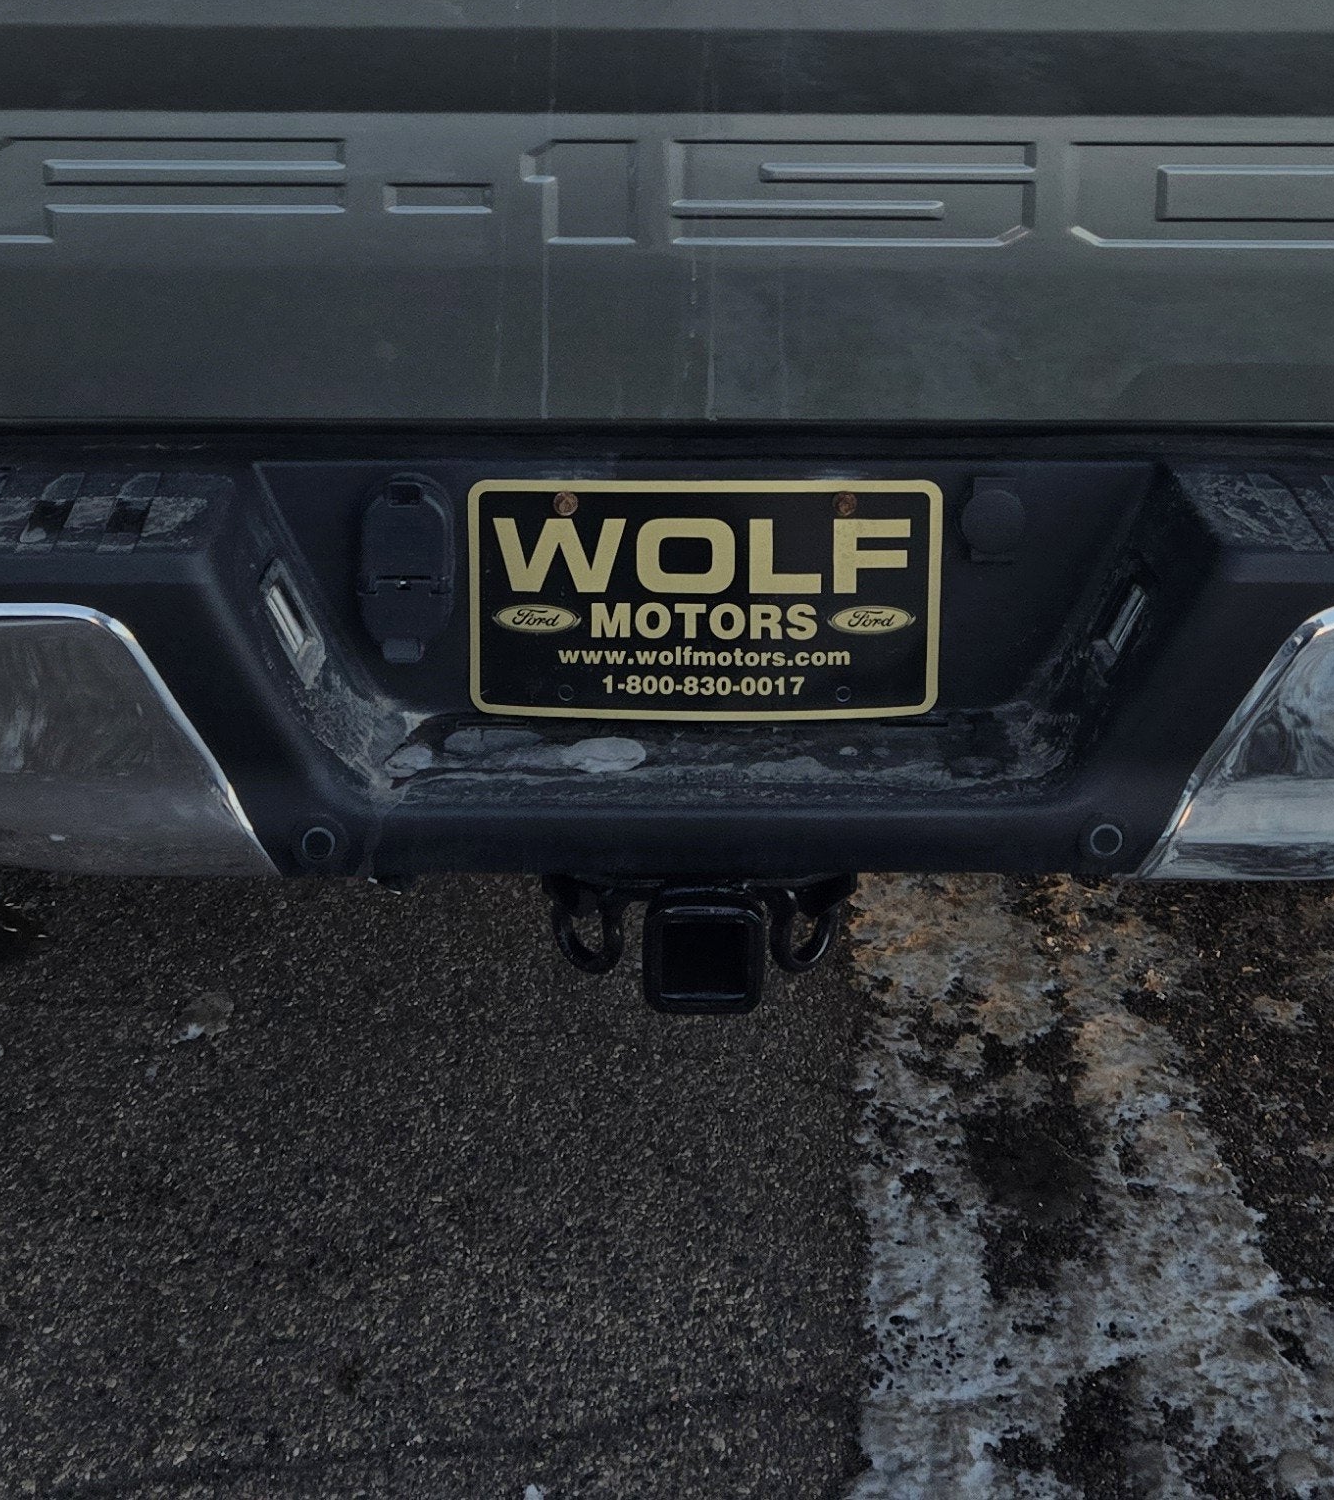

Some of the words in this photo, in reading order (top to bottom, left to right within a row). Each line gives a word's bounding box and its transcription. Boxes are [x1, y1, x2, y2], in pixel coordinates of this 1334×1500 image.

[492, 517, 911, 594] WOLF
[590, 602, 817, 640] MOTORS
[558, 646, 851, 667] www.wolfmotors.com
[602, 674, 805, 696] 1-800-830-0017
